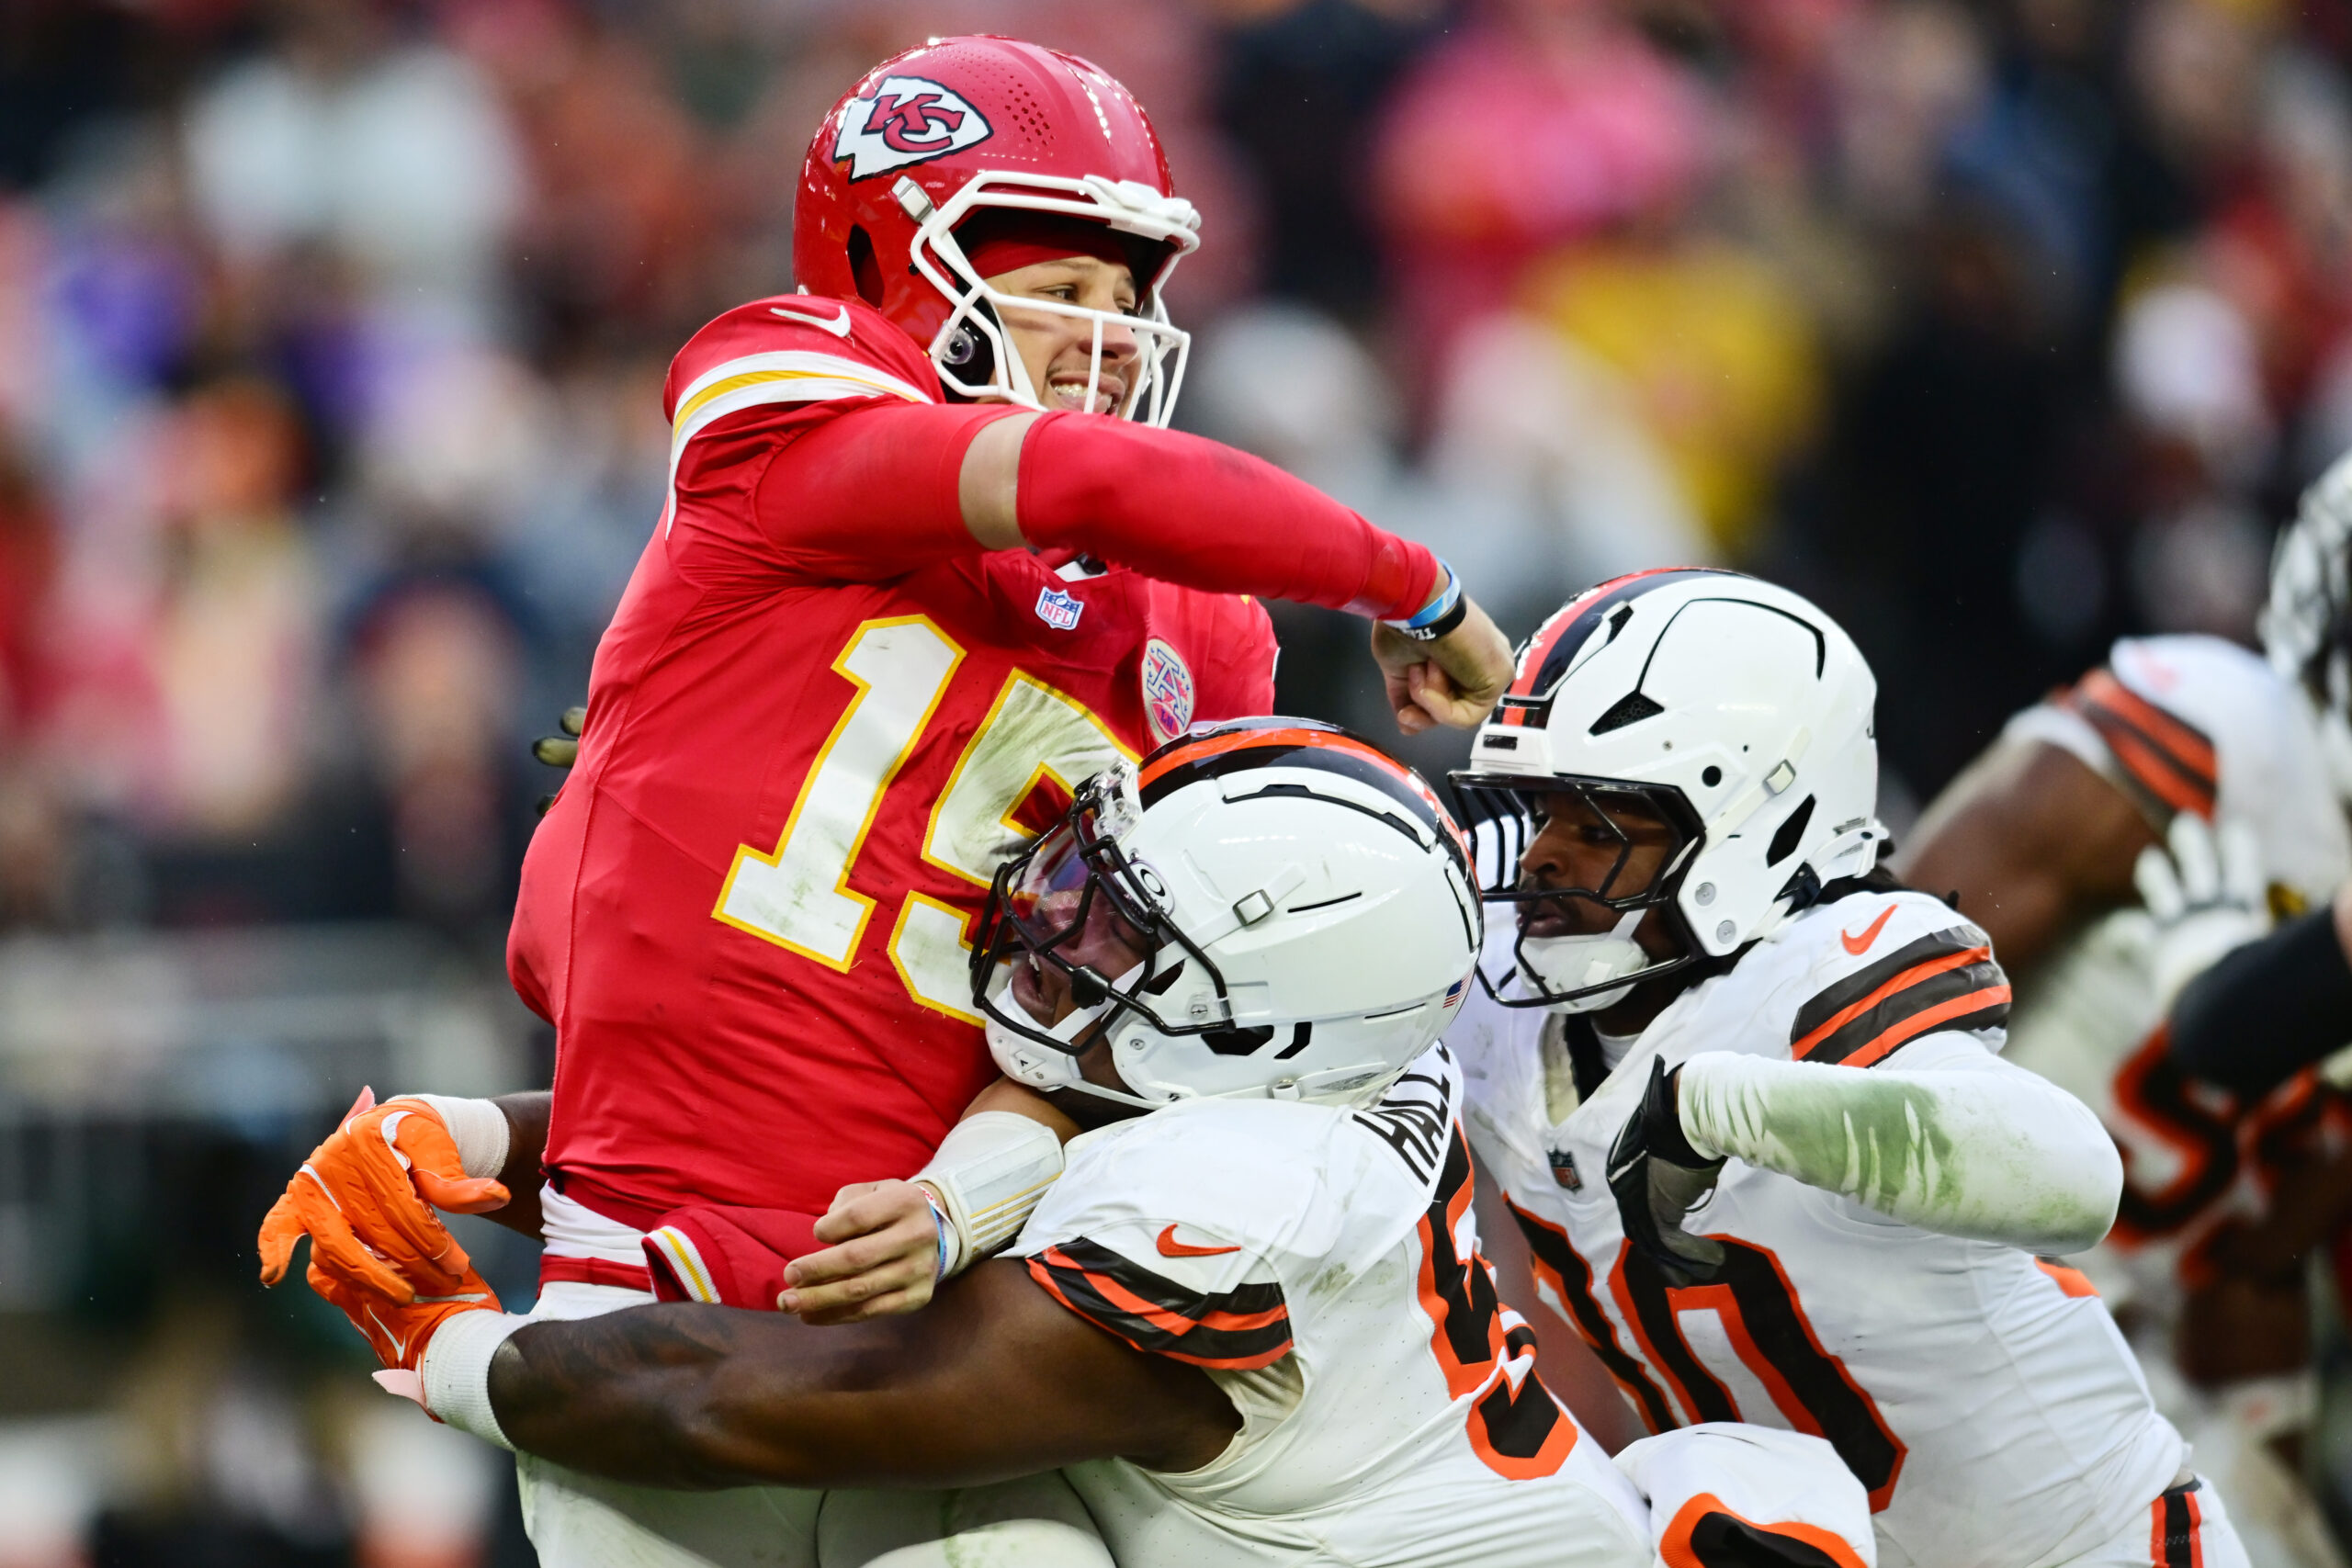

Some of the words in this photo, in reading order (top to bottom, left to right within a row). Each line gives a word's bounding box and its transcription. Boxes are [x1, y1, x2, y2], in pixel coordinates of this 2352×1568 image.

[860, 93, 967, 154] KC
[1041, 602, 1070, 626] NFL
[1351, 1067, 1451, 1188] HALL
